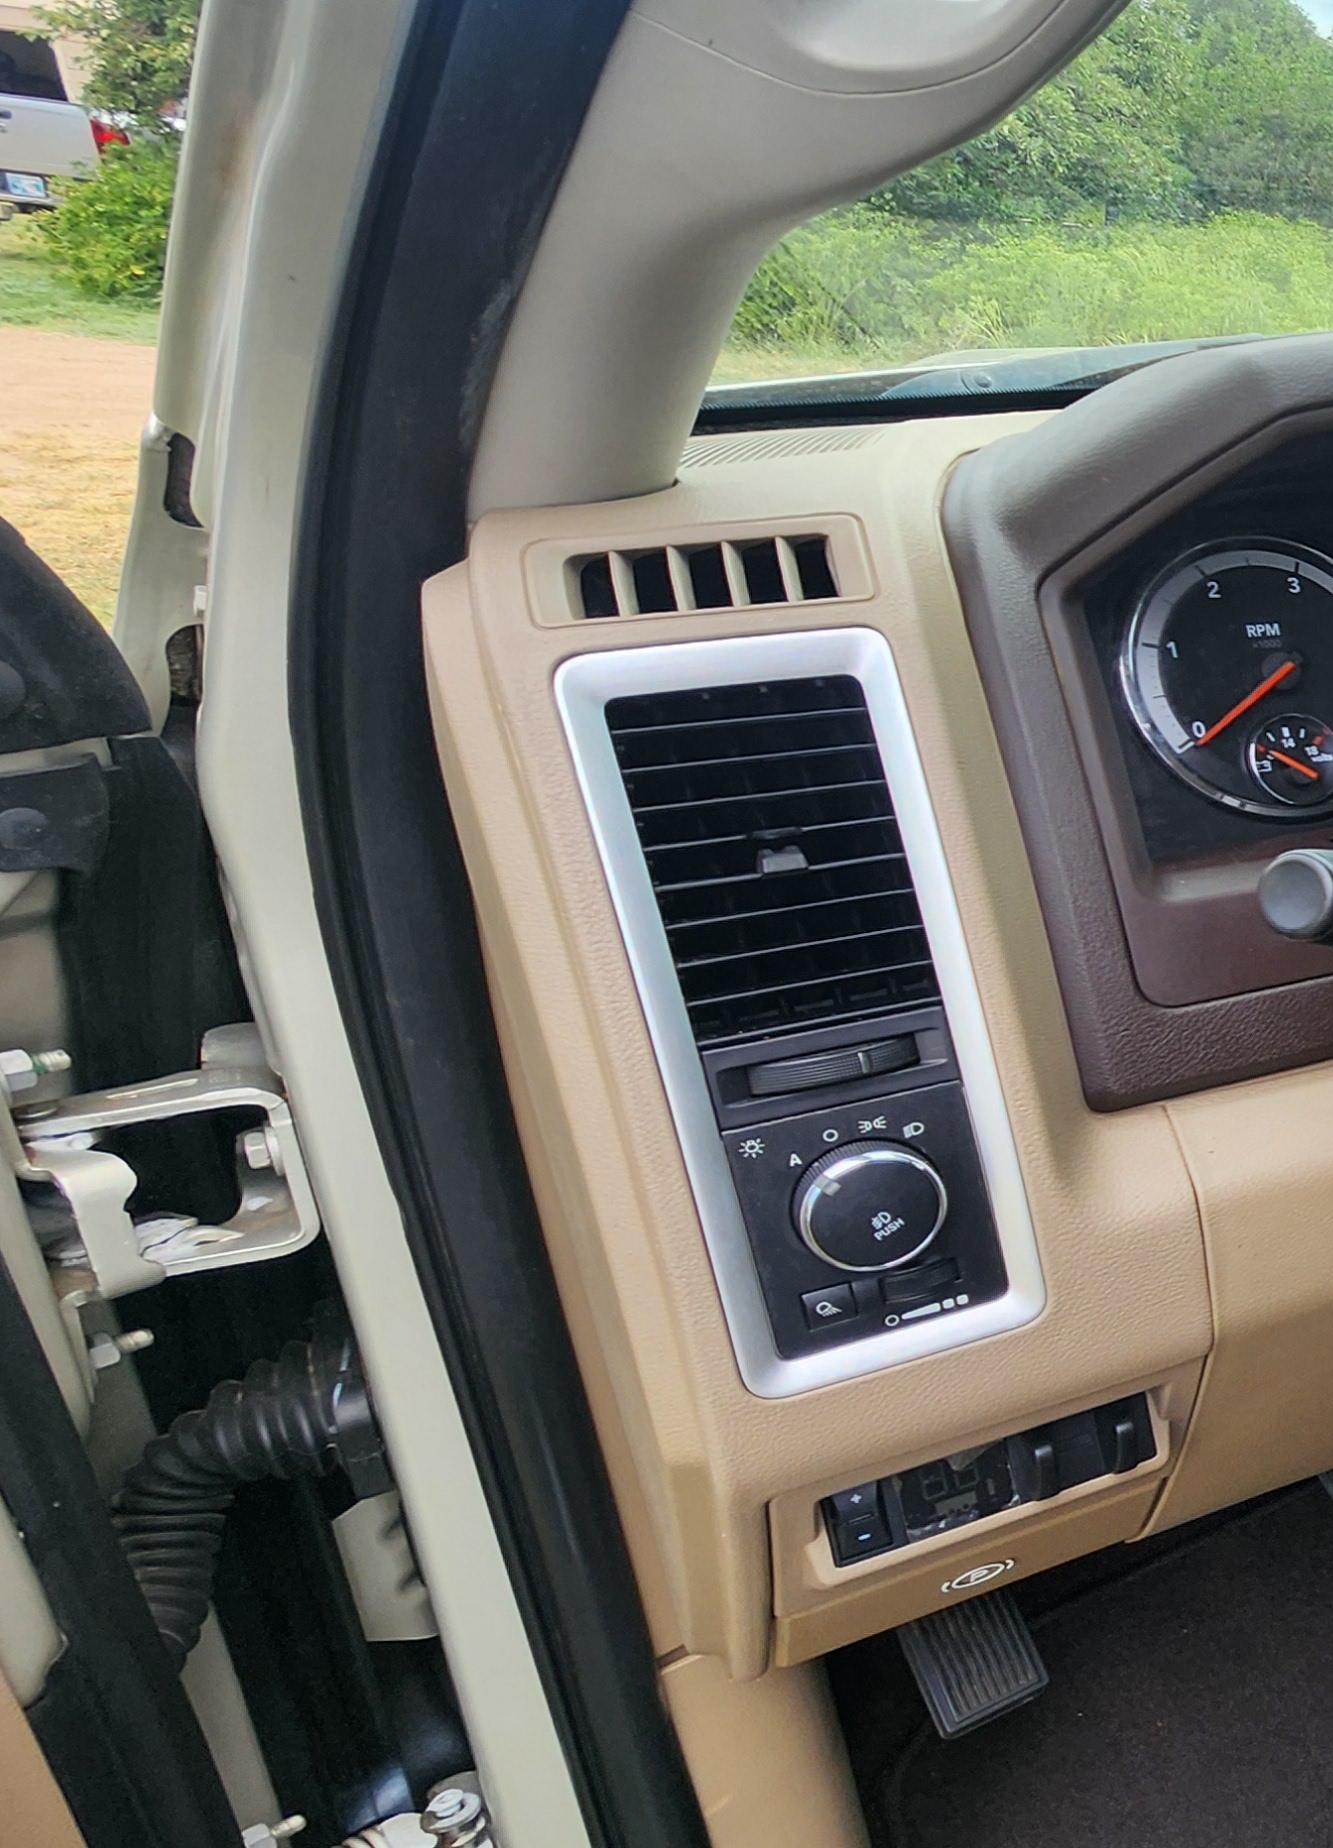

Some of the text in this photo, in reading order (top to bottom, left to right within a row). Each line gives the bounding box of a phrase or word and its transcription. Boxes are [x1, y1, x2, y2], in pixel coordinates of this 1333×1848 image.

[1207, 581, 1221, 599] 2
[1287, 577, 1301, 594] 3
[1246, 622, 1281, 638] RPM
[1166, 641, 1179, 659] 1
[1191, 720, 1206, 738] 0
[1281, 738, 1296, 749] 14
[789, 1153, 803, 1167] A
[873, 1217, 905, 1242] PUSH
